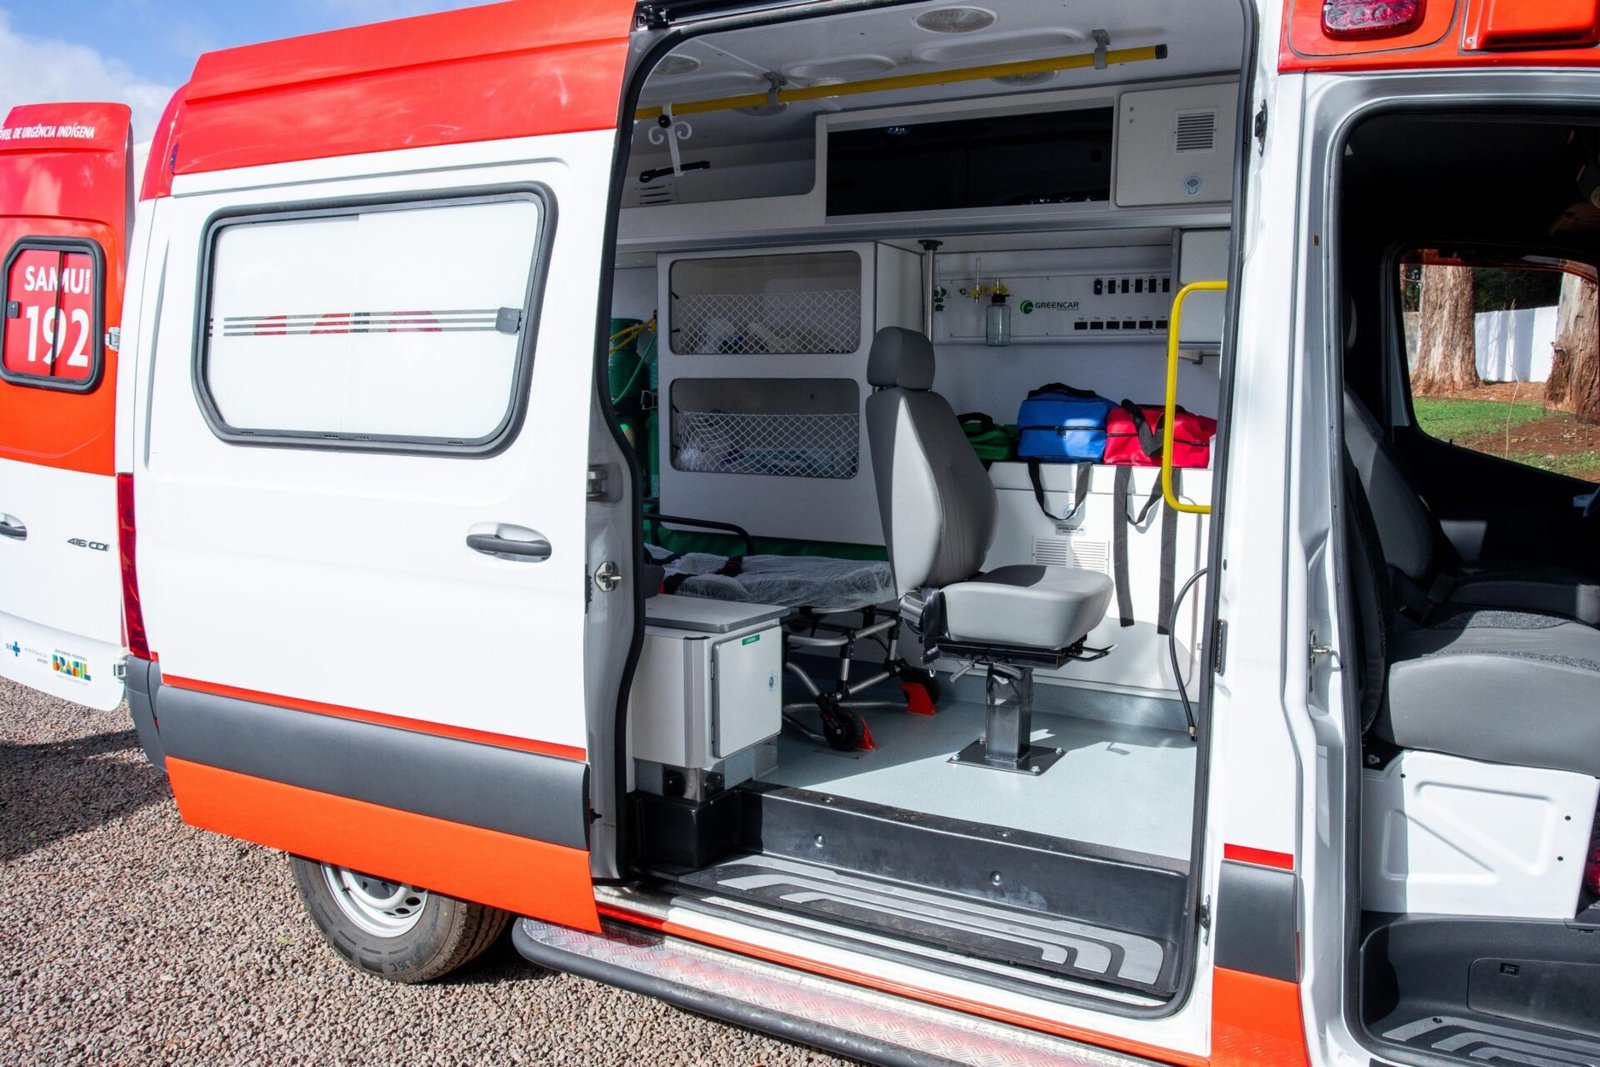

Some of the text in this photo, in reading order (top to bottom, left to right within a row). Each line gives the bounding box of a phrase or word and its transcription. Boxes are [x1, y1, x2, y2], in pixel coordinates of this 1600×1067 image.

[13, 127, 22, 139] DE
[21, 122, 56, 139] URGÊNCIA
[57, 122, 95, 139] INDÍGENA
[1035, 301, 1079, 309] GREENCAR
[26, 305, 90, 367] 192
[67, 538, 87, 548] 416
[52, 654, 92, 681] BRASIL
